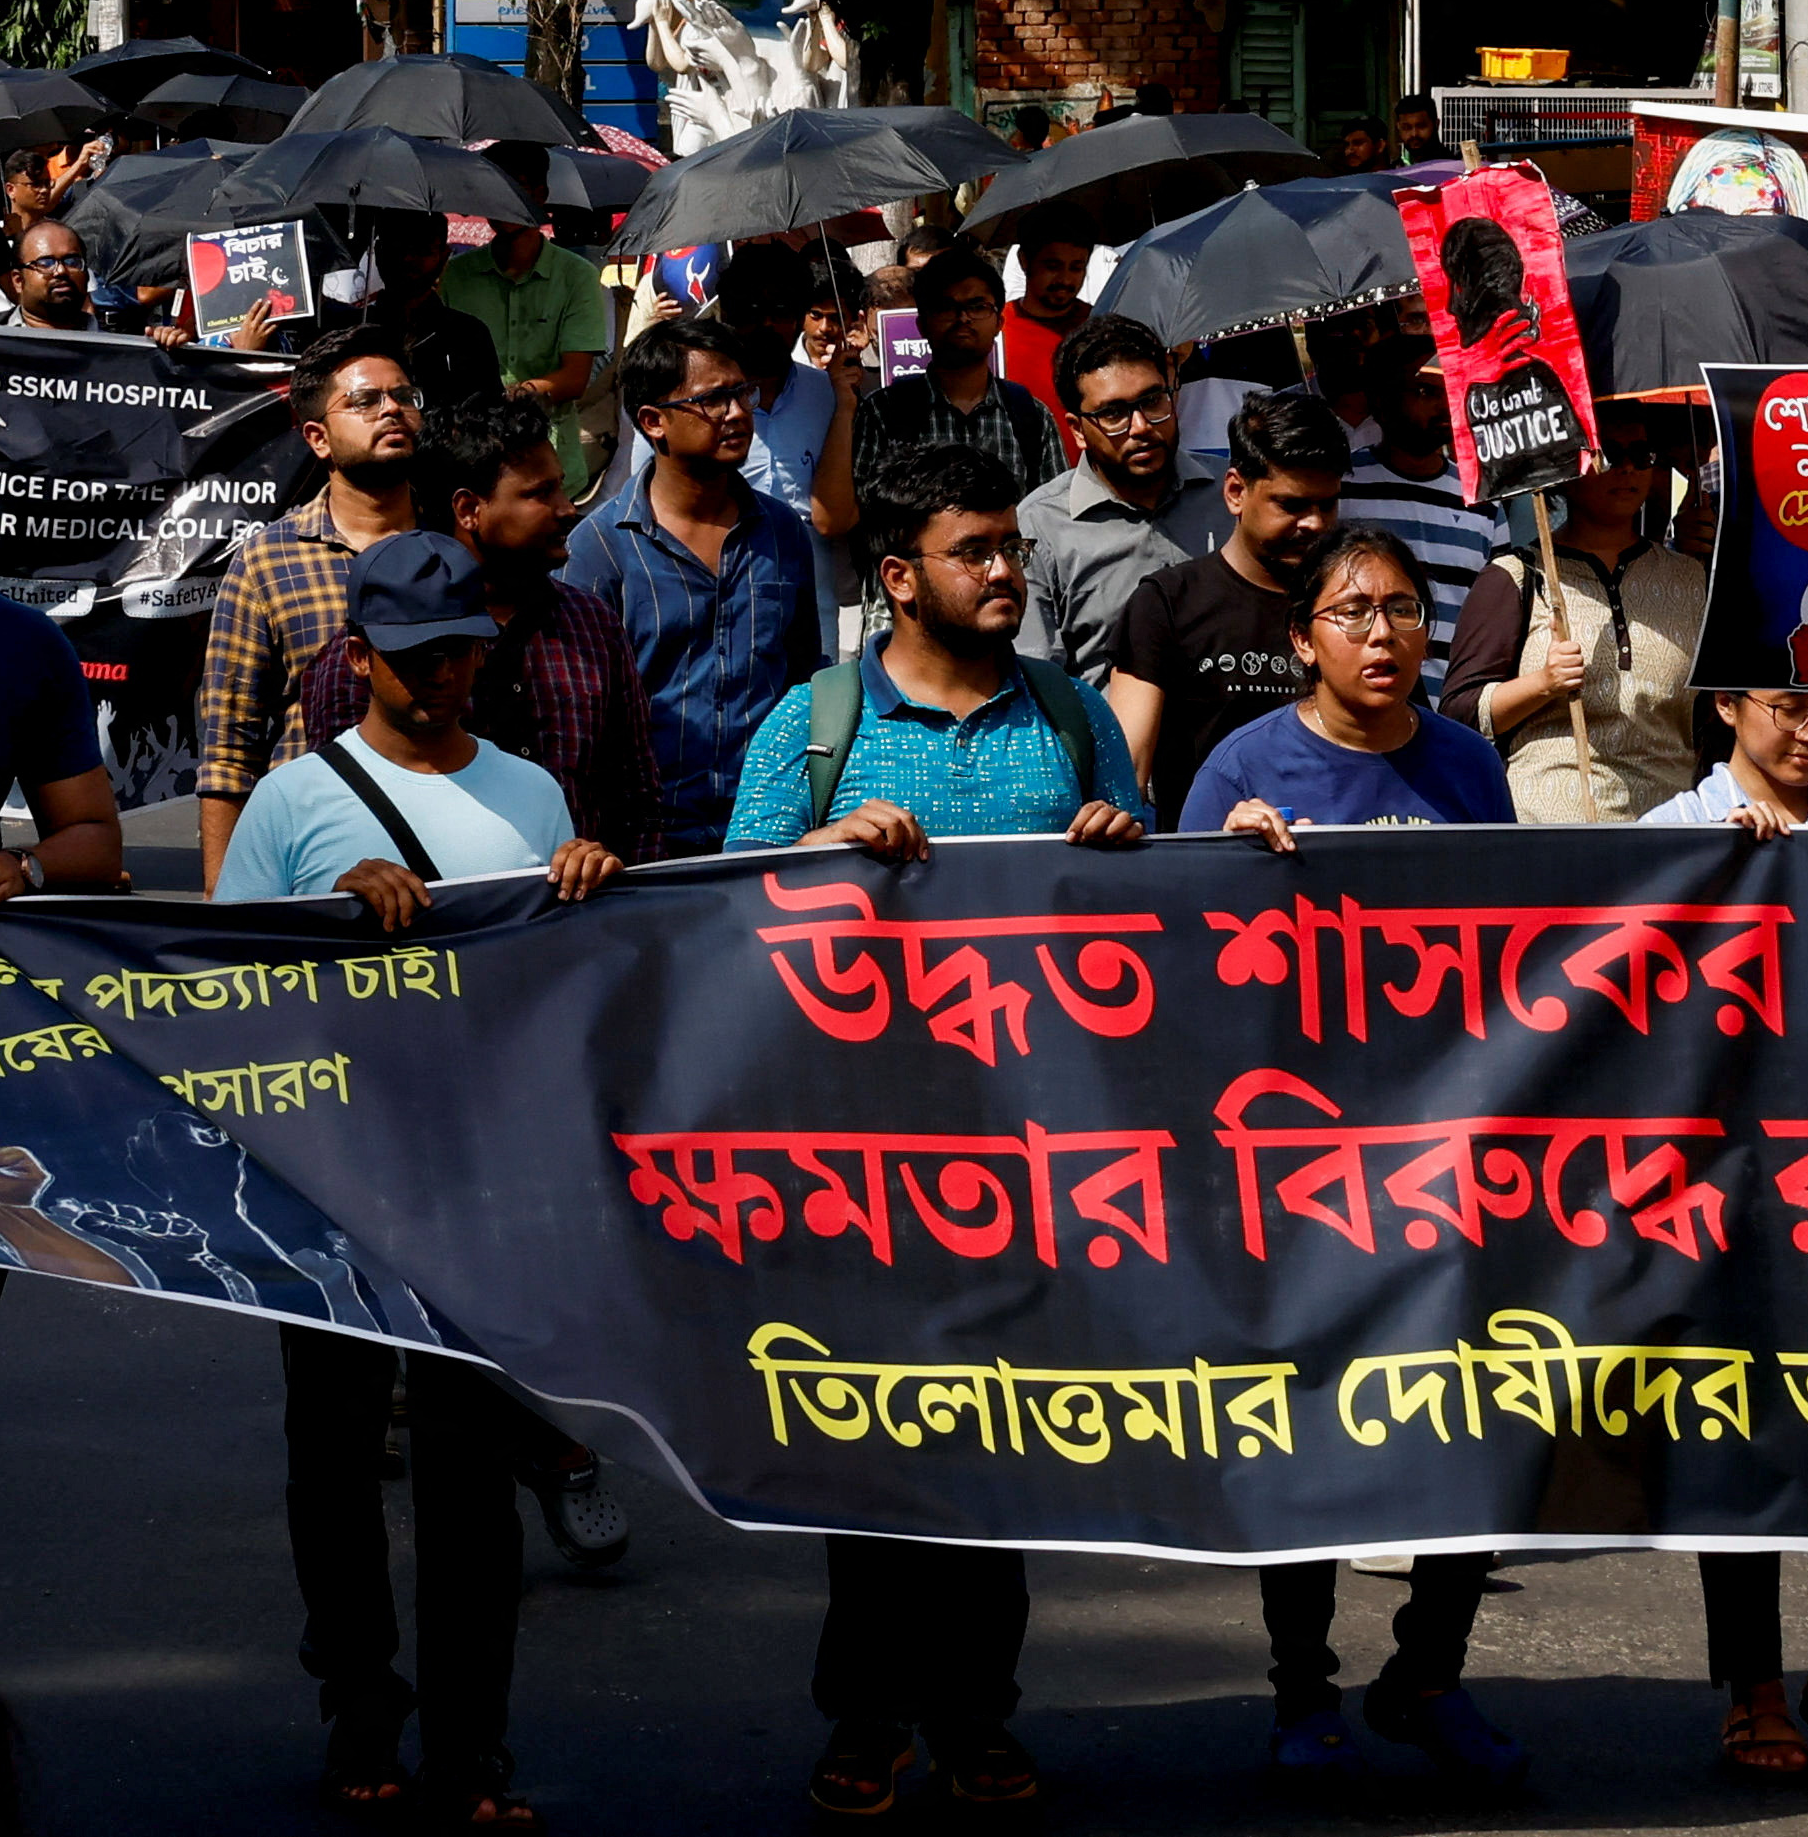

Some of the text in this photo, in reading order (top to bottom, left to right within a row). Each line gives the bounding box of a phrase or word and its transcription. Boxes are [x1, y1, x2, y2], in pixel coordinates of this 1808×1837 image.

[223, 233, 284, 257] বিচার
[227, 256, 268, 284] চাই
[7, 375, 79, 401] SSKM
[86, 381, 213, 411] HOSPITAL
[1471, 376, 1543, 420] We want
[1471, 405, 1568, 463] JUSTICE
[52, 478, 108, 502] FOR
[115, 483, 166, 503] THE
[181, 481, 278, 505] JUNIOR
[25, 515, 153, 541] MEDICAL
[158, 517, 267, 542] COLLEG
[1248, 685, 1297, 695] ENDLESS
[84, 961, 319, 1021] পদত্যাগ
[757, 872, 1163, 1066] উদ্ধত
[1203, 893, 1795, 1044] শাসকের
[159, 1052, 351, 1117] পসারণ
[611, 1119, 1176, 1270] ক্ষমতার
[1214, 1067, 1727, 1261] বিরুদ্ধে
[748, 1322, 1297, 1465] তিলোত্তমার
[1337, 1309, 1754, 1448] দোষীদের
